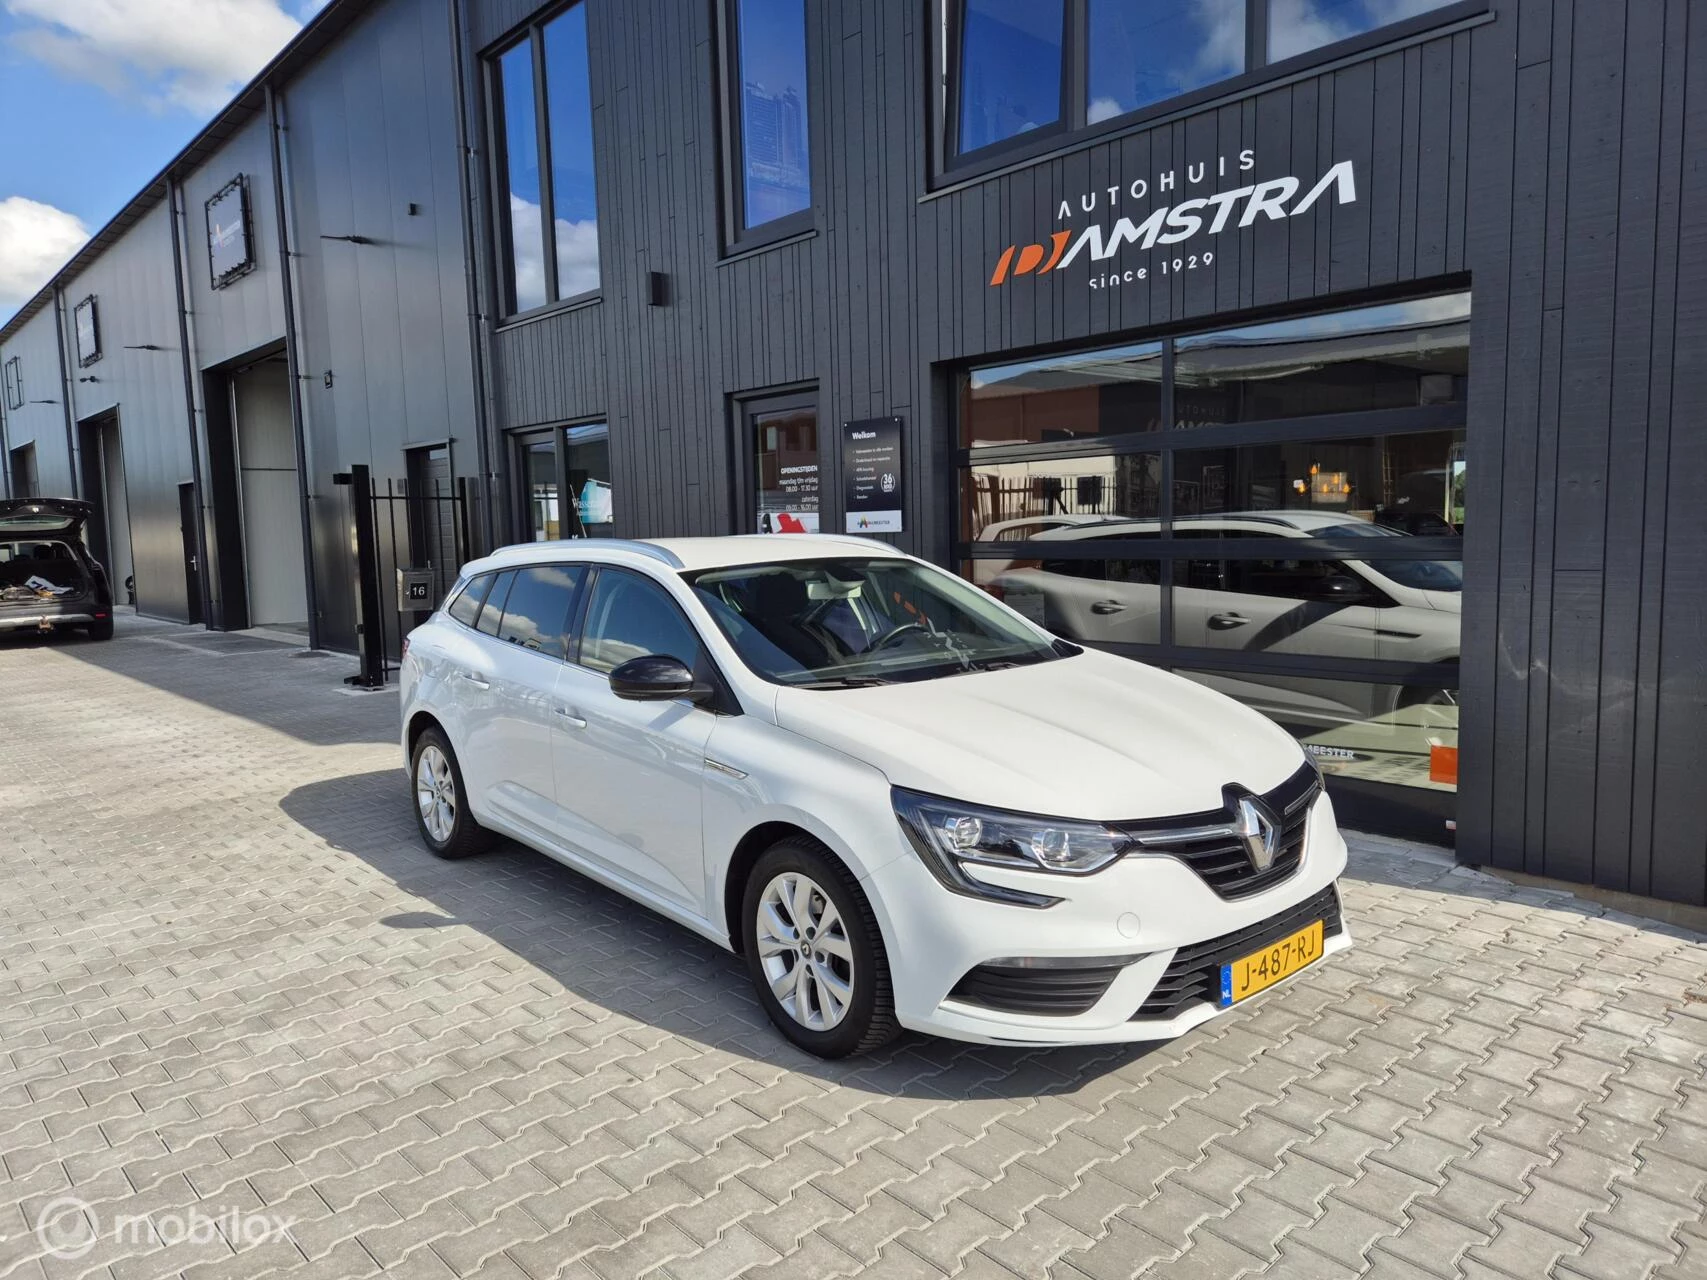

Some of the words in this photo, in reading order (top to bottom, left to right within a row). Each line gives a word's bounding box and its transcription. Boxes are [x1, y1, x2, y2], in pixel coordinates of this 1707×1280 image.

[1057, 149, 1256, 220] AUTOHUIS
[1089, 266, 1148, 289] since
[1161, 251, 1214, 275] 1929
[852, 431, 876, 440] Welkom
[780, 465, 818, 474] OPENINGSTIJDEN
[883, 473, 893, 485] 36
[412, 586, 425, 596] 16
[1241, 929, 1316, 992] J-487-RJ
[1222, 989, 1231, 999] NL
